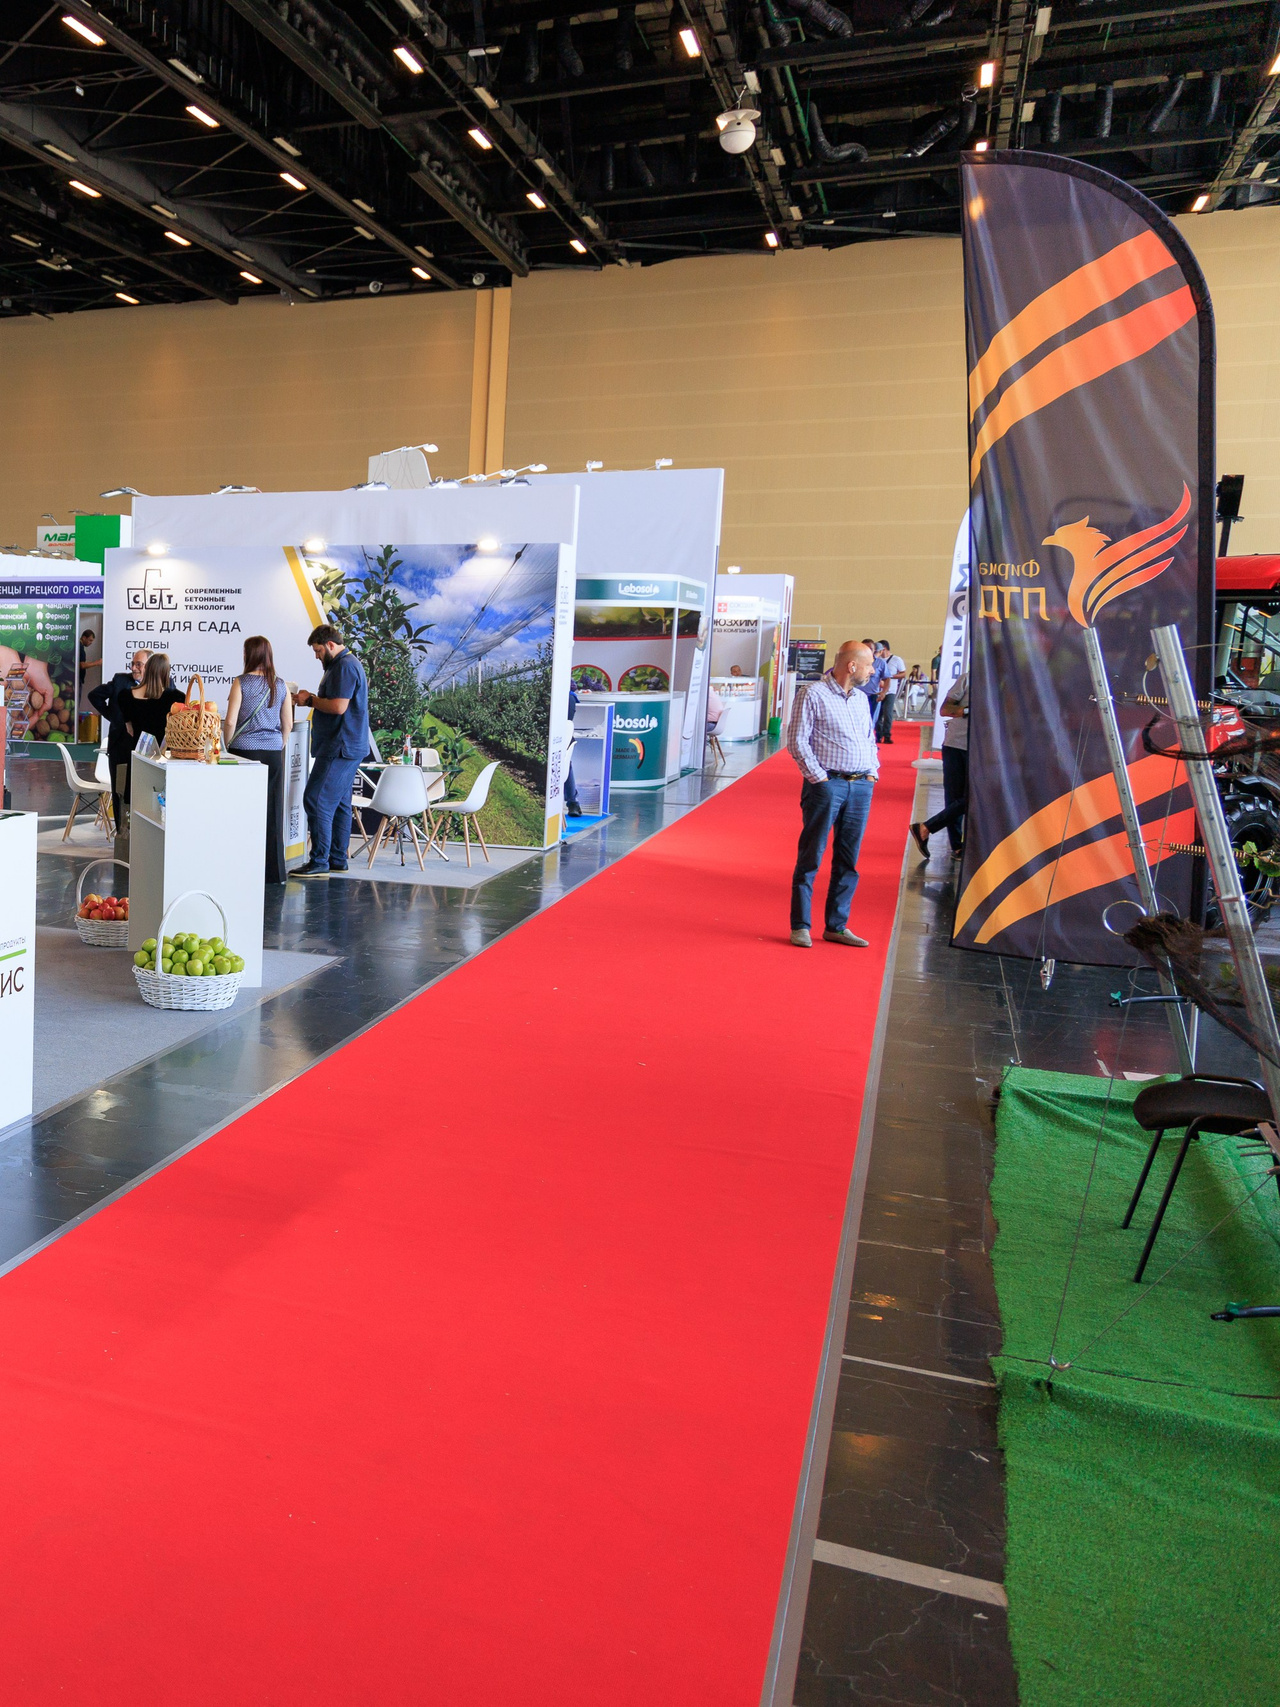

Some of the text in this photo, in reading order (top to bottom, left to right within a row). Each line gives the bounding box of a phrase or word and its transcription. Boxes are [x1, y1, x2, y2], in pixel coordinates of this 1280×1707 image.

[25, 585, 69, 596] ГРЕЦКОГО
[72, 586, 102, 595] ОРЕХА
[618, 583, 653, 594] Lebosol
[45, 612, 70, 620] Фернор
[125, 620, 241, 634] ВСЕ ДЛЯ САДА
[125, 641, 169, 649] СТОЛБЫ
[612, 714, 649, 729] ebosol
[0, 936, 27, 952] ПРОДУКТЫ
